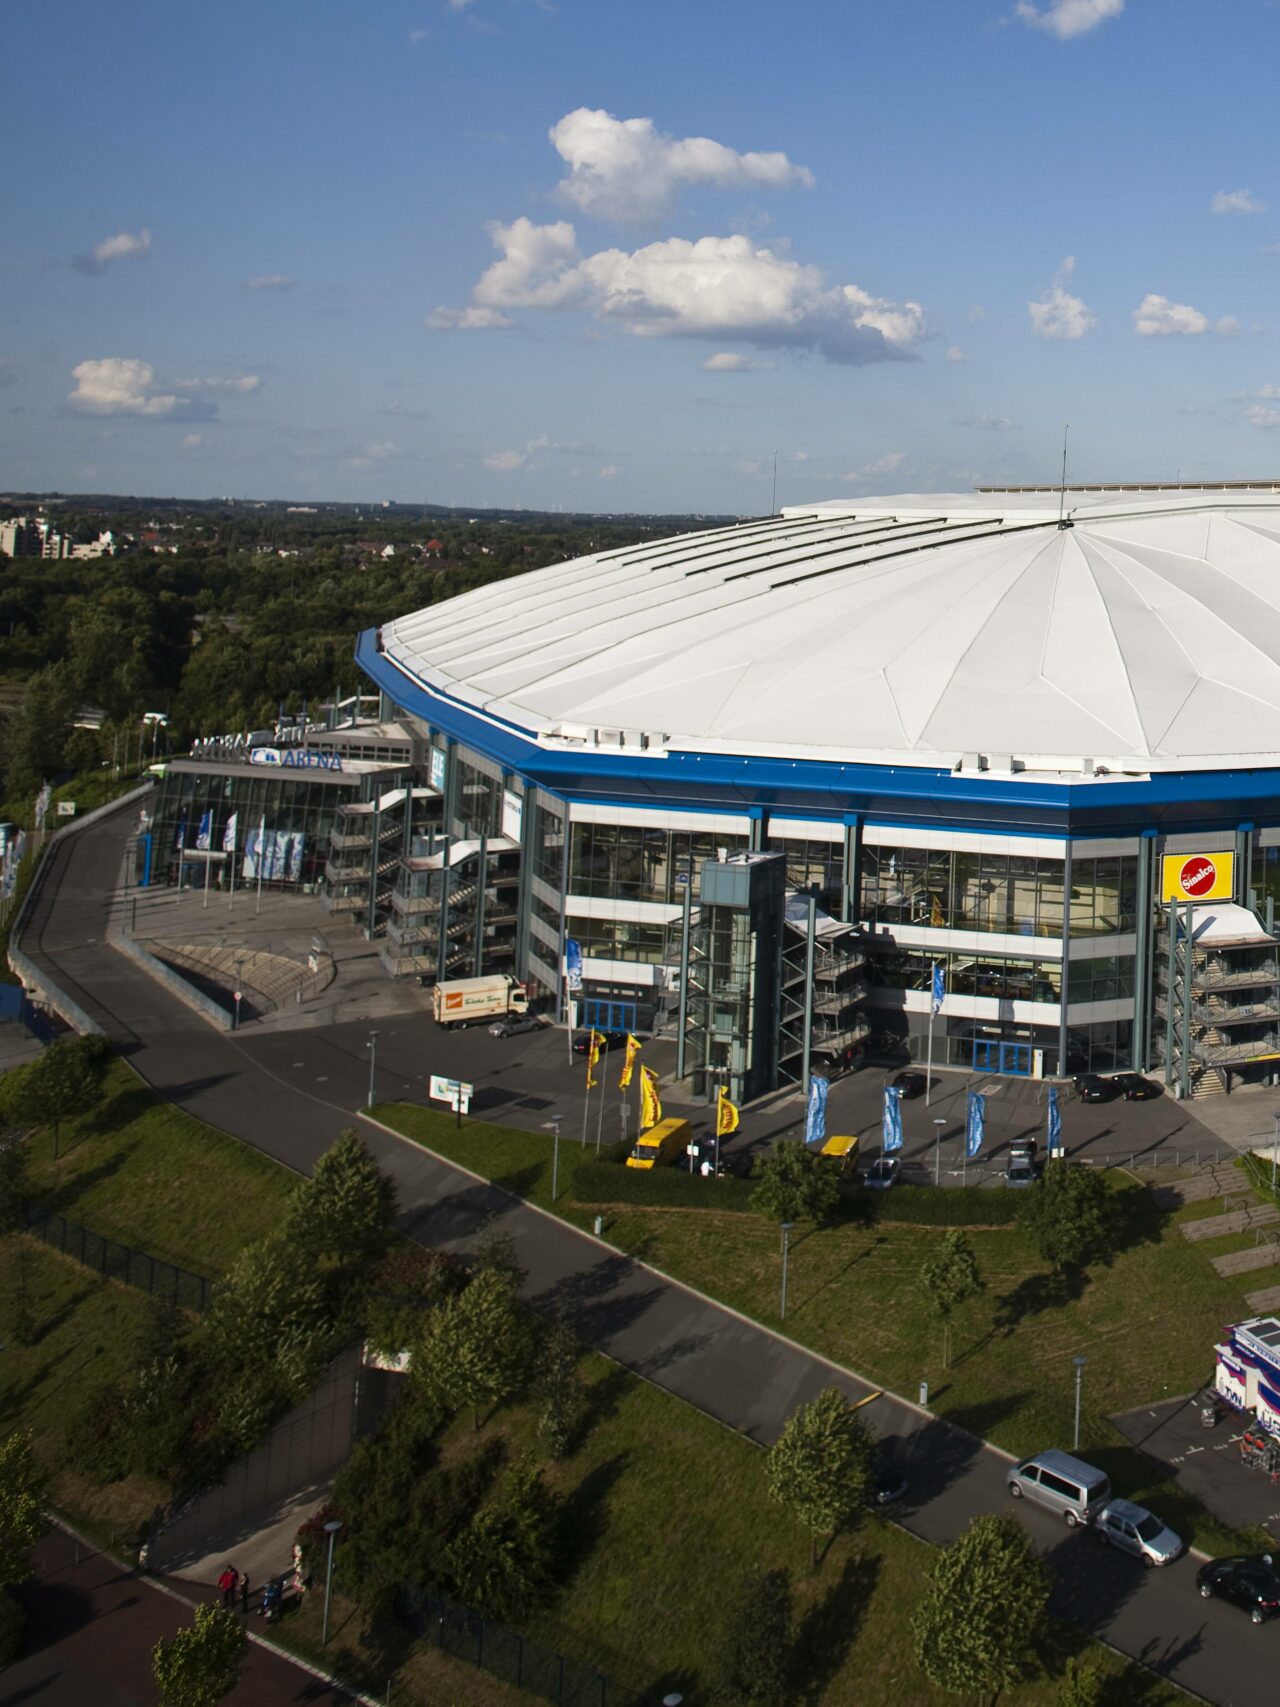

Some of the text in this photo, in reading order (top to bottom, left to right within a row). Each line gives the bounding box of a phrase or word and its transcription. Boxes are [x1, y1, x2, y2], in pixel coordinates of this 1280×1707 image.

[283, 749, 343, 772] ARENA
[1182, 864, 1214, 890] Sinalco
[1225, 1386, 1242, 1405] TVN
